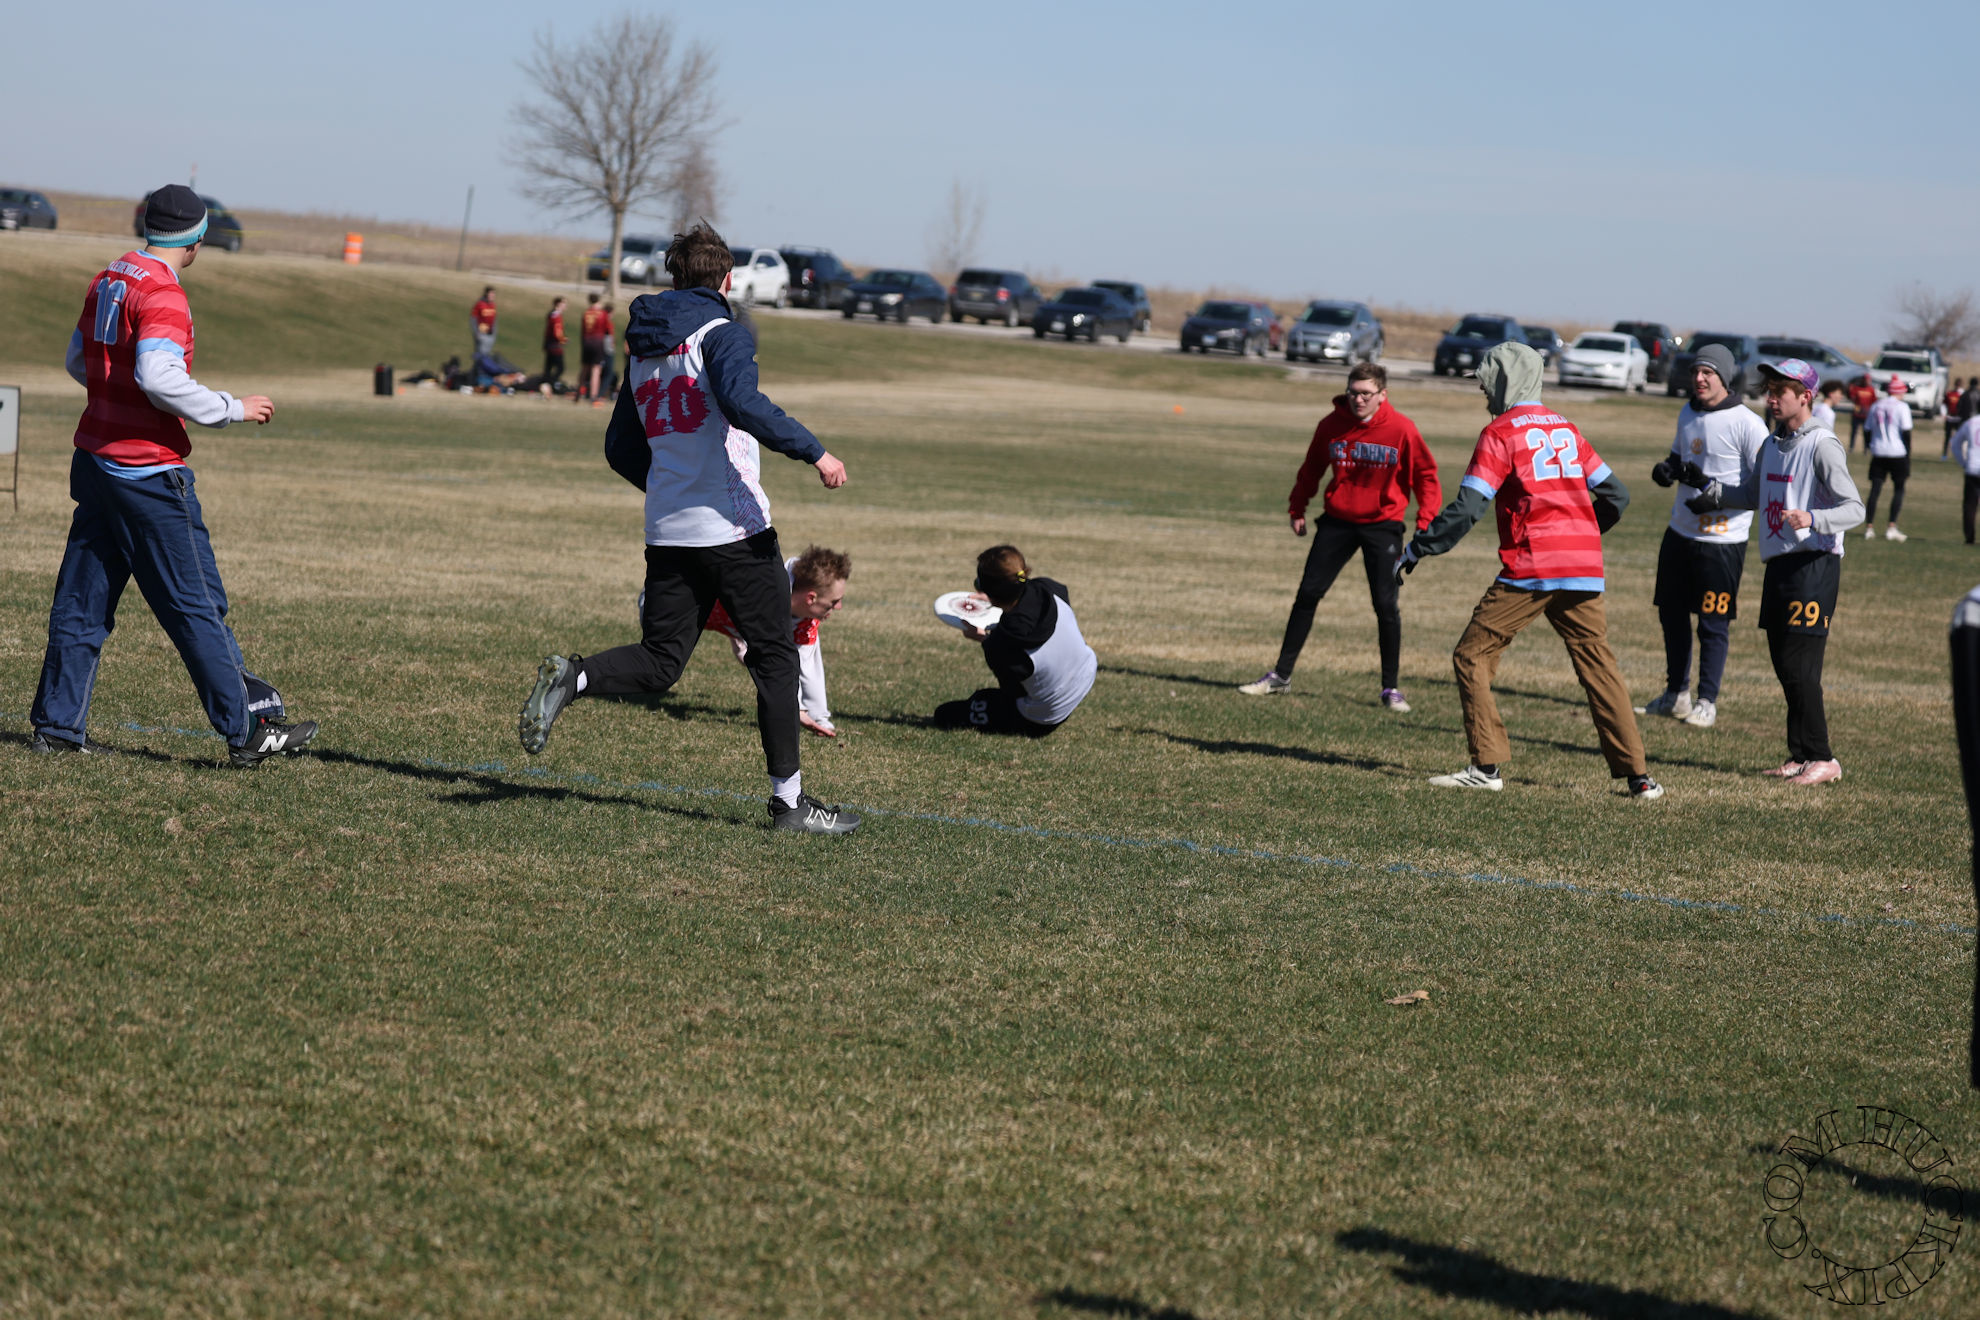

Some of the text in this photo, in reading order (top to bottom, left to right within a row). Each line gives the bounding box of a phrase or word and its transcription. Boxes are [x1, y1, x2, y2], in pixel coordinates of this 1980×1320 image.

[634, 374, 711, 439] 20
[1525, 427, 1584, 482] 22
[1697, 513, 1729, 535] 88
[1701, 590, 1732, 615] 88
[1787, 600, 1821, 628] 29
